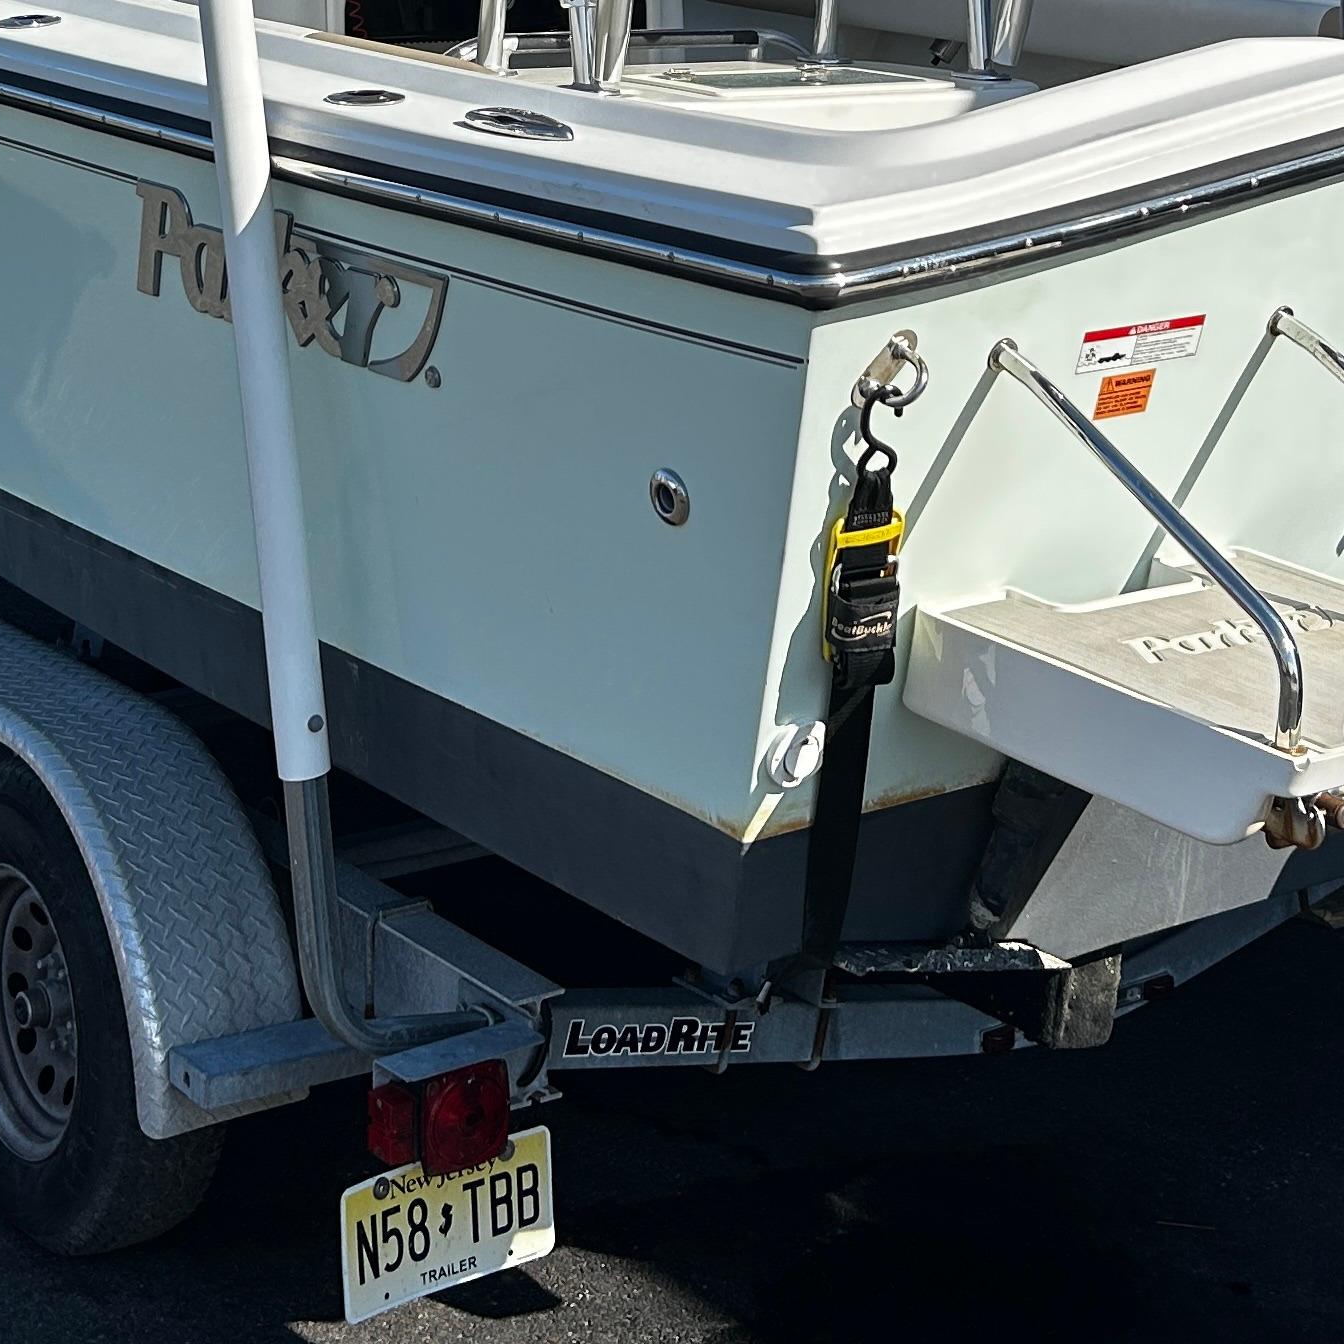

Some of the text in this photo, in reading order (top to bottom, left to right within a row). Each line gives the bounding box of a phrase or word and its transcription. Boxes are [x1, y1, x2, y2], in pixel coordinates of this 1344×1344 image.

[136, 178, 450, 383] Paker
[1136, 321, 1171, 334] DANGER
[1115, 374, 1152, 387] WARNING
[389, 1173, 433, 1200] New
[356, 1162, 540, 1286] N58 TBB
[420, 1255, 478, 1286] TRAILER
